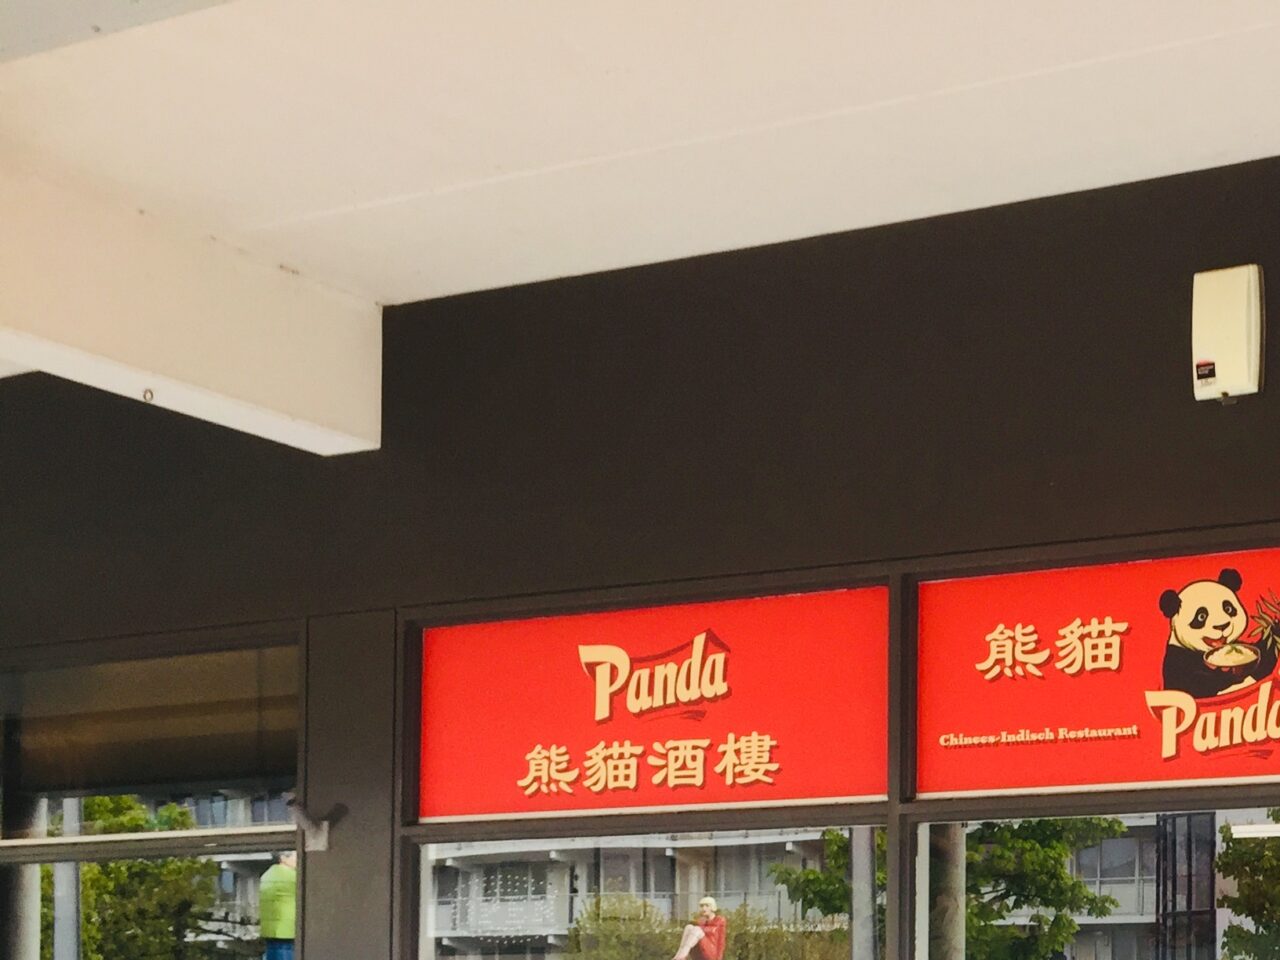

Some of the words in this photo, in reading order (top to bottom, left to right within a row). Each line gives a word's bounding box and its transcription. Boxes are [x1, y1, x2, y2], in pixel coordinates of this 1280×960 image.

[579, 633, 728, 721] Panda
[976, 617, 1127, 679] 熊貓
[517, 731, 780, 795] 熊貓酒樓
[939, 727, 1055, 746] Chinees-Indisch
[1058, 725, 1138, 739] Restaurant
